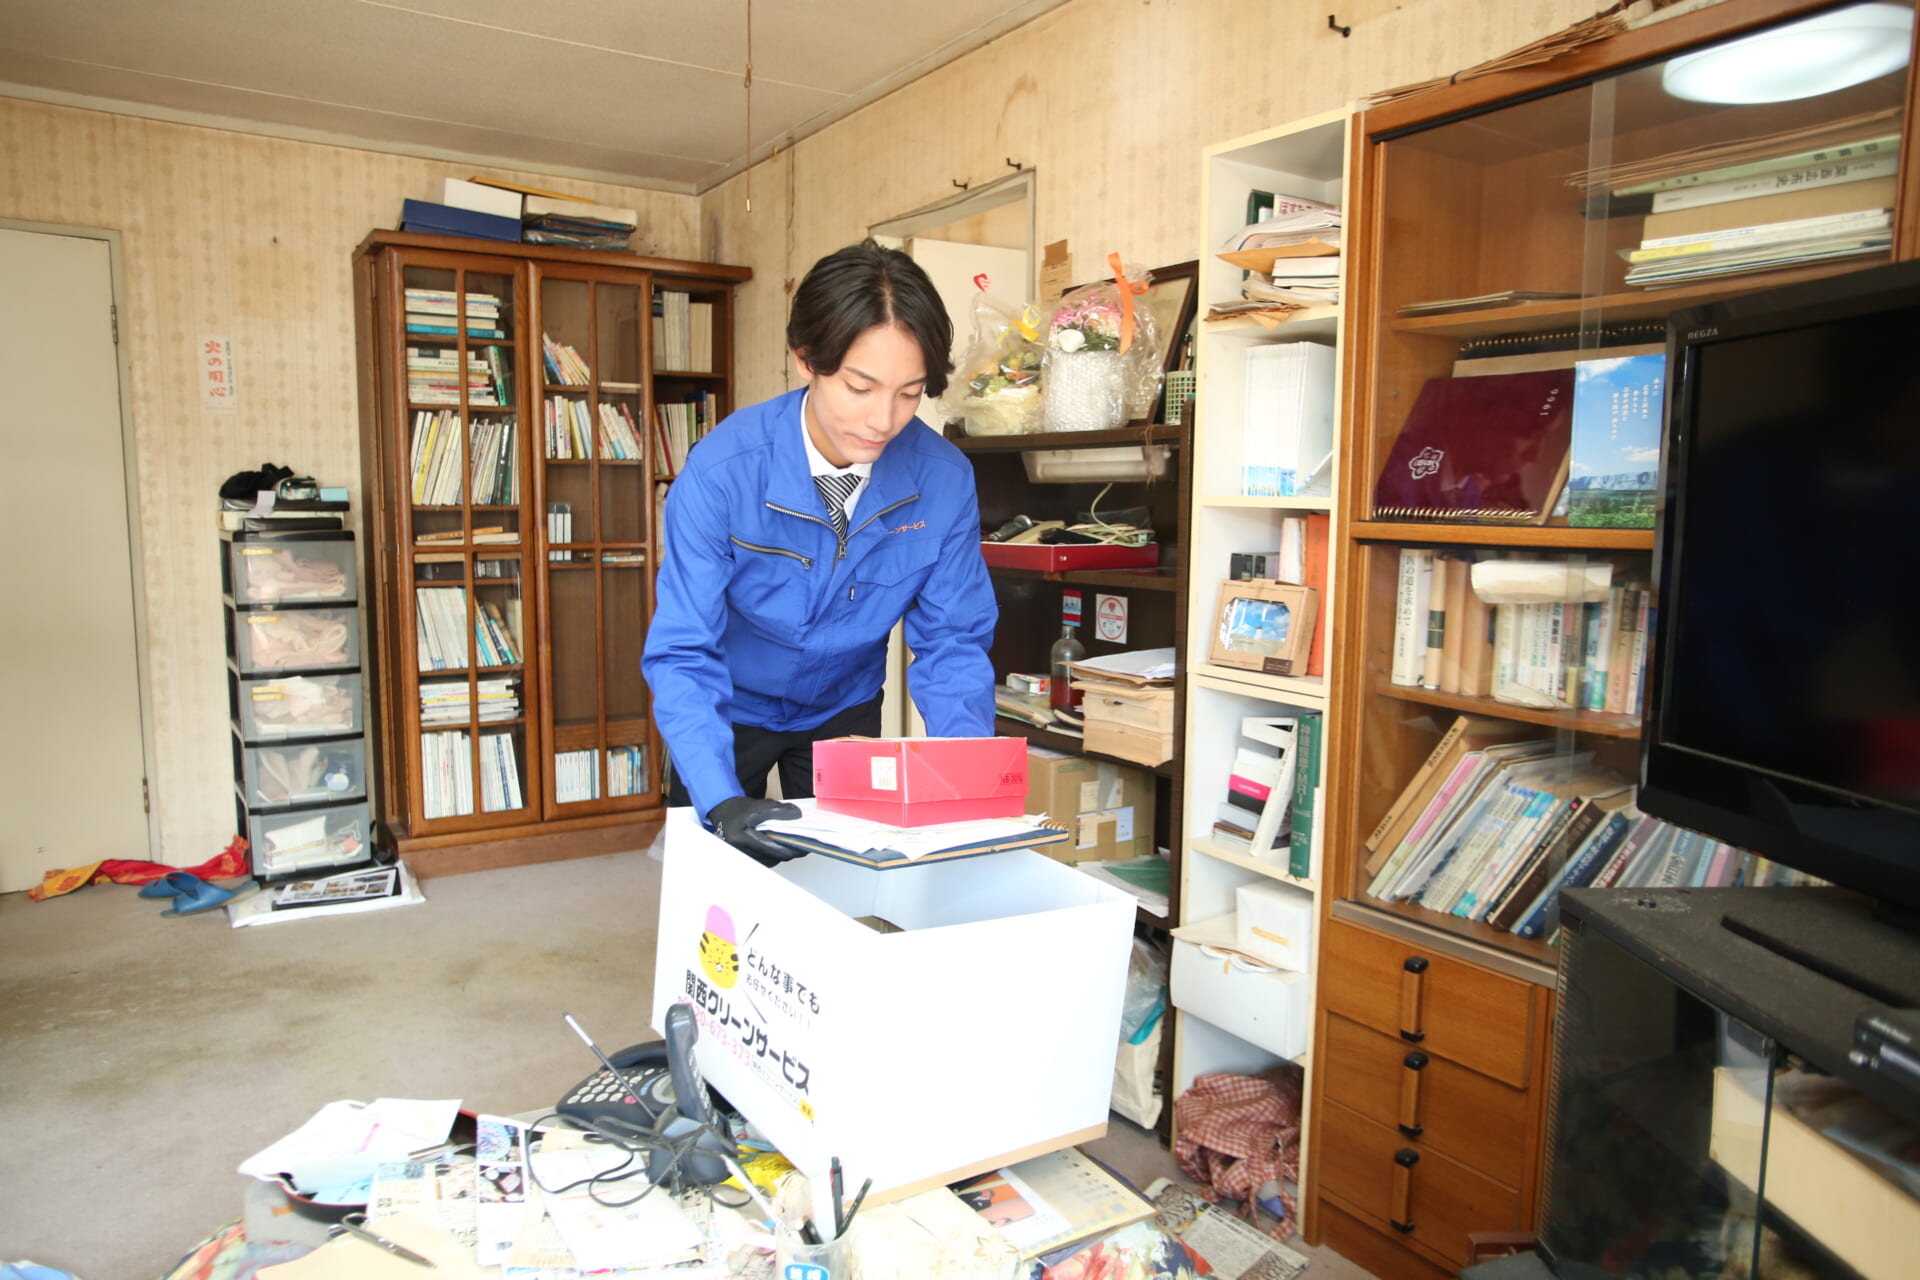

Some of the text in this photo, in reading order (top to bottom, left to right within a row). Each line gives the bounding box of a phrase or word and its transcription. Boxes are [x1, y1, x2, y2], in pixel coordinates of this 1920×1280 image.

[1688, 328, 1718, 340] REGZA
[204, 340, 226, 397] 火の用心
[747, 947, 819, 1014] どんな事でも
[685, 968, 810, 1096] 関西クリーンサービス
